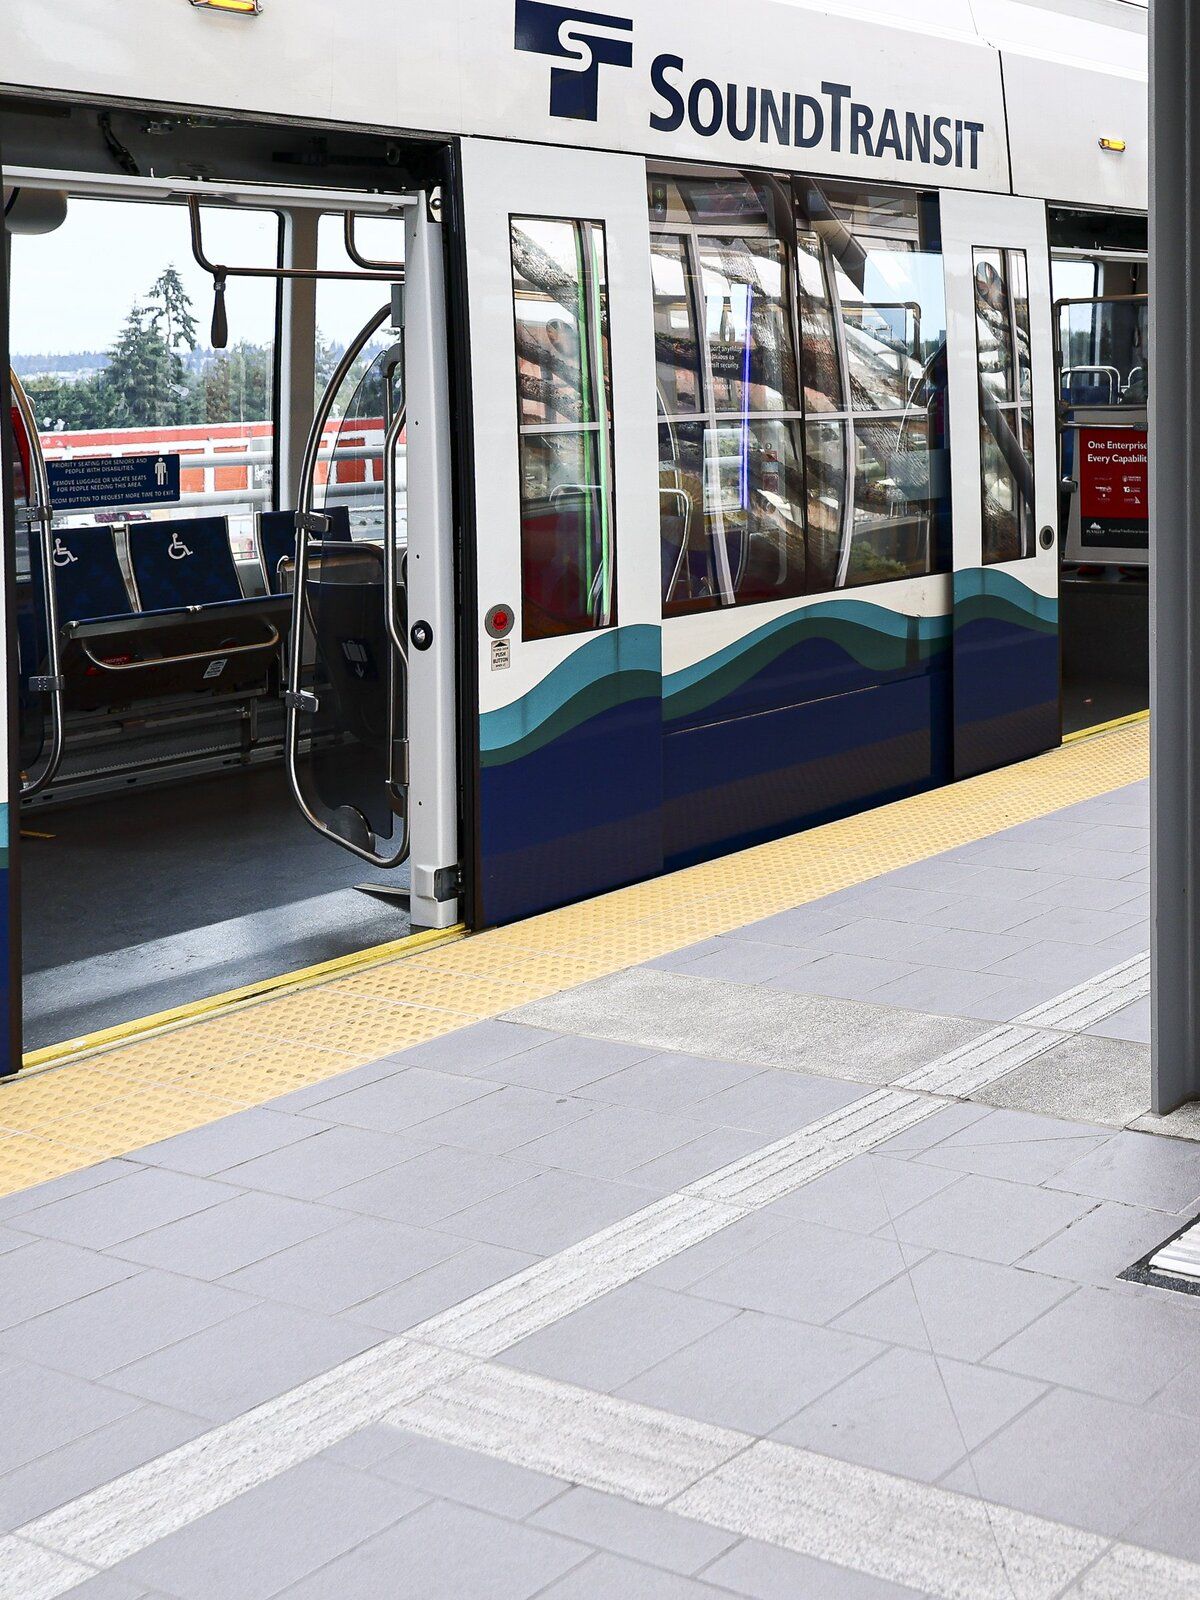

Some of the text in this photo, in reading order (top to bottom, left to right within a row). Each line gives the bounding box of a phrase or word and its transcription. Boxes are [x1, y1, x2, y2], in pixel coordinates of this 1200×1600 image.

[1088, 441, 1105, 449] One
[1088, 454, 1148, 464] Every Capabilit
